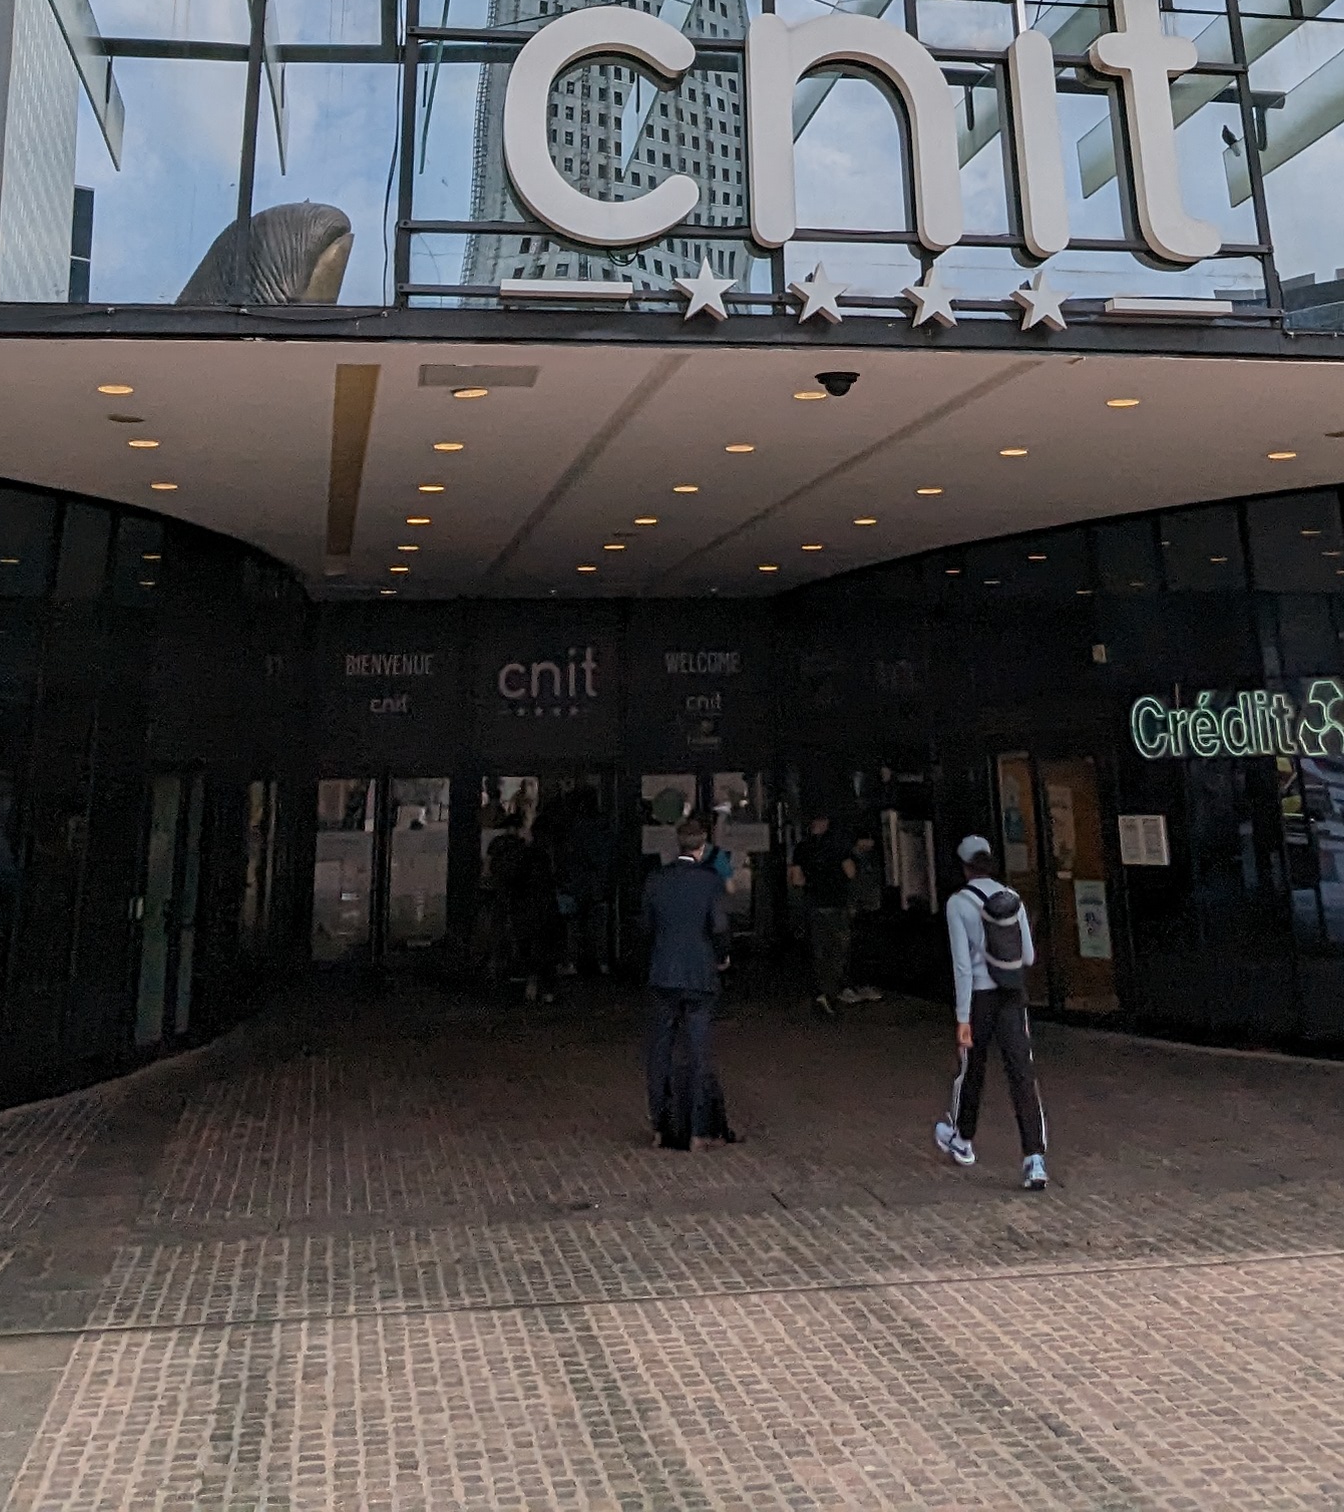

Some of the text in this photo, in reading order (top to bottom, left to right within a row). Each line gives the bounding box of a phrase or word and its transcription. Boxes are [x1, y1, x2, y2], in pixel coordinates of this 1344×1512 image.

[345, 653, 434, 676] BIENVENUE
[498, 647, 599, 698] cnit
[664, 652, 741, 675] WELCOME
[1130, 690, 1296, 759] Crédit
